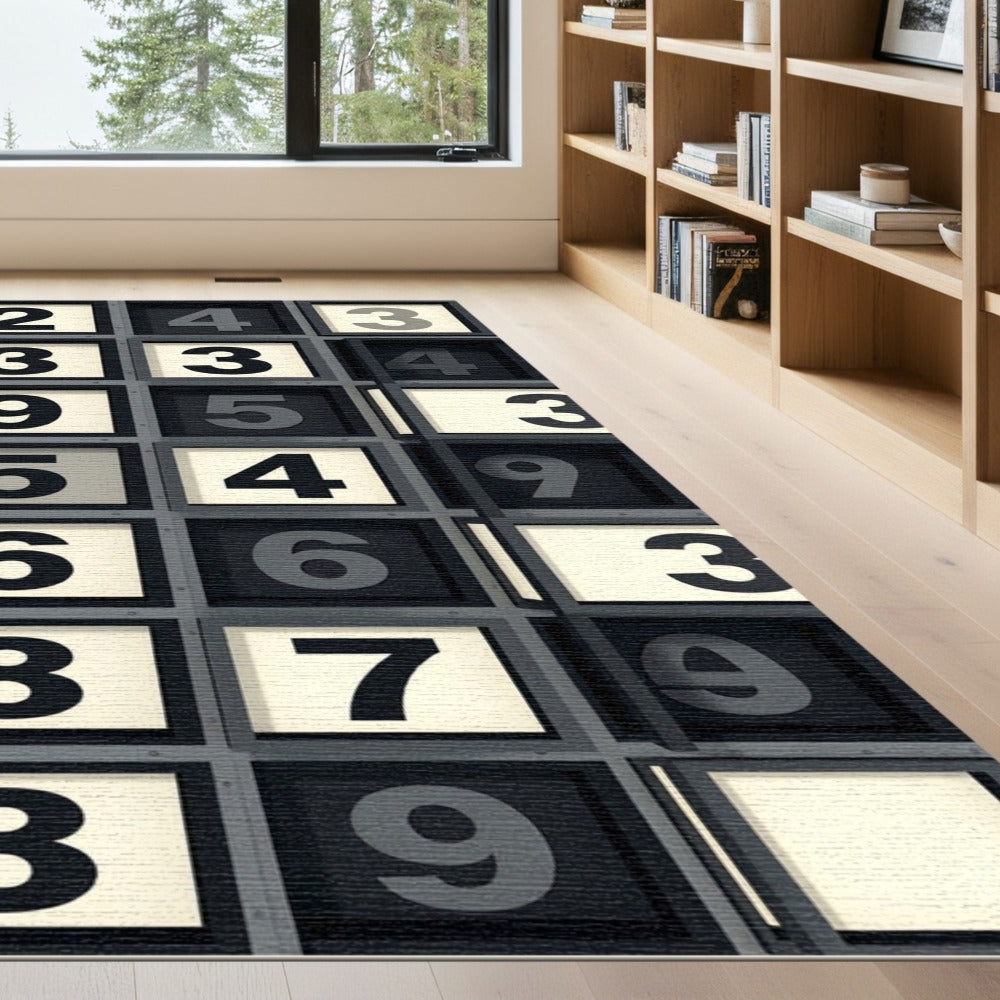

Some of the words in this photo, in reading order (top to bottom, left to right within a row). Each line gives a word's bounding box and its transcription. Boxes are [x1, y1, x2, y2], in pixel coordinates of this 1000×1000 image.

[167, 307, 252, 332] 4
[346, 307, 432, 330] 3
[181, 346, 273, 375] 3
[385, 348, 477, 376] 4
[204, 394, 303, 429] 5
[506, 394, 604, 428] 3
[223, 453, 347, 498] 4
[474, 454, 579, 498] 9
[252, 530, 388, 590] 6
[644, 533, 794, 593] 3
[290, 638, 440, 721] 7
[350, 785, 556, 912] 9
